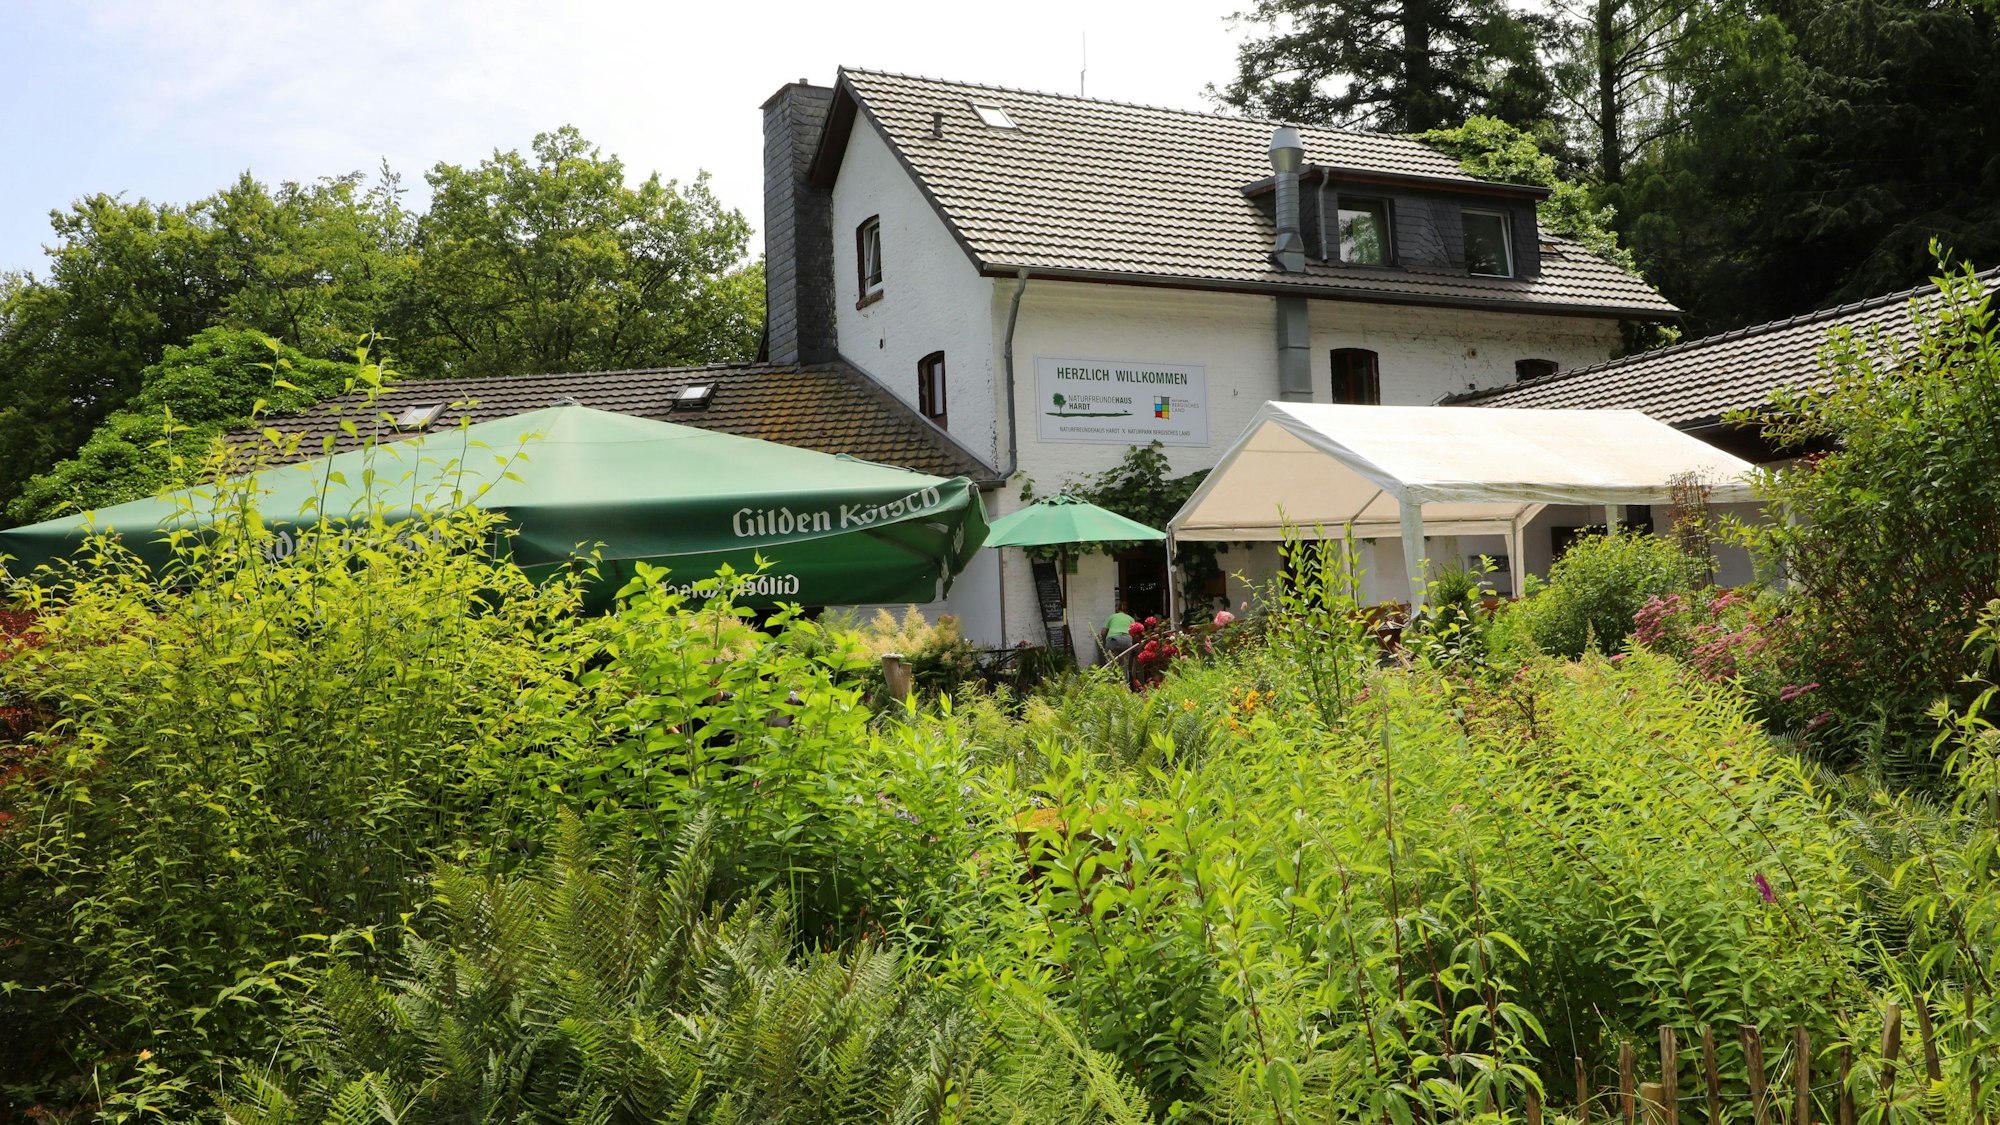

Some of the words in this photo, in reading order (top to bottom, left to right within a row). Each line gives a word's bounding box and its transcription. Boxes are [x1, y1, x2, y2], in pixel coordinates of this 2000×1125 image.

[1057, 367, 1110, 381] HERZLICH
[1115, 370, 1188, 385] WILLKOMMEN
[1068, 394, 1133, 405] NATURFREUNDEHAUS
[1068, 403, 1091, 411] HARDT
[1060, 426, 1106, 434] NATURFREUNDEHAUS
[732, 506, 832, 537] Gilden
